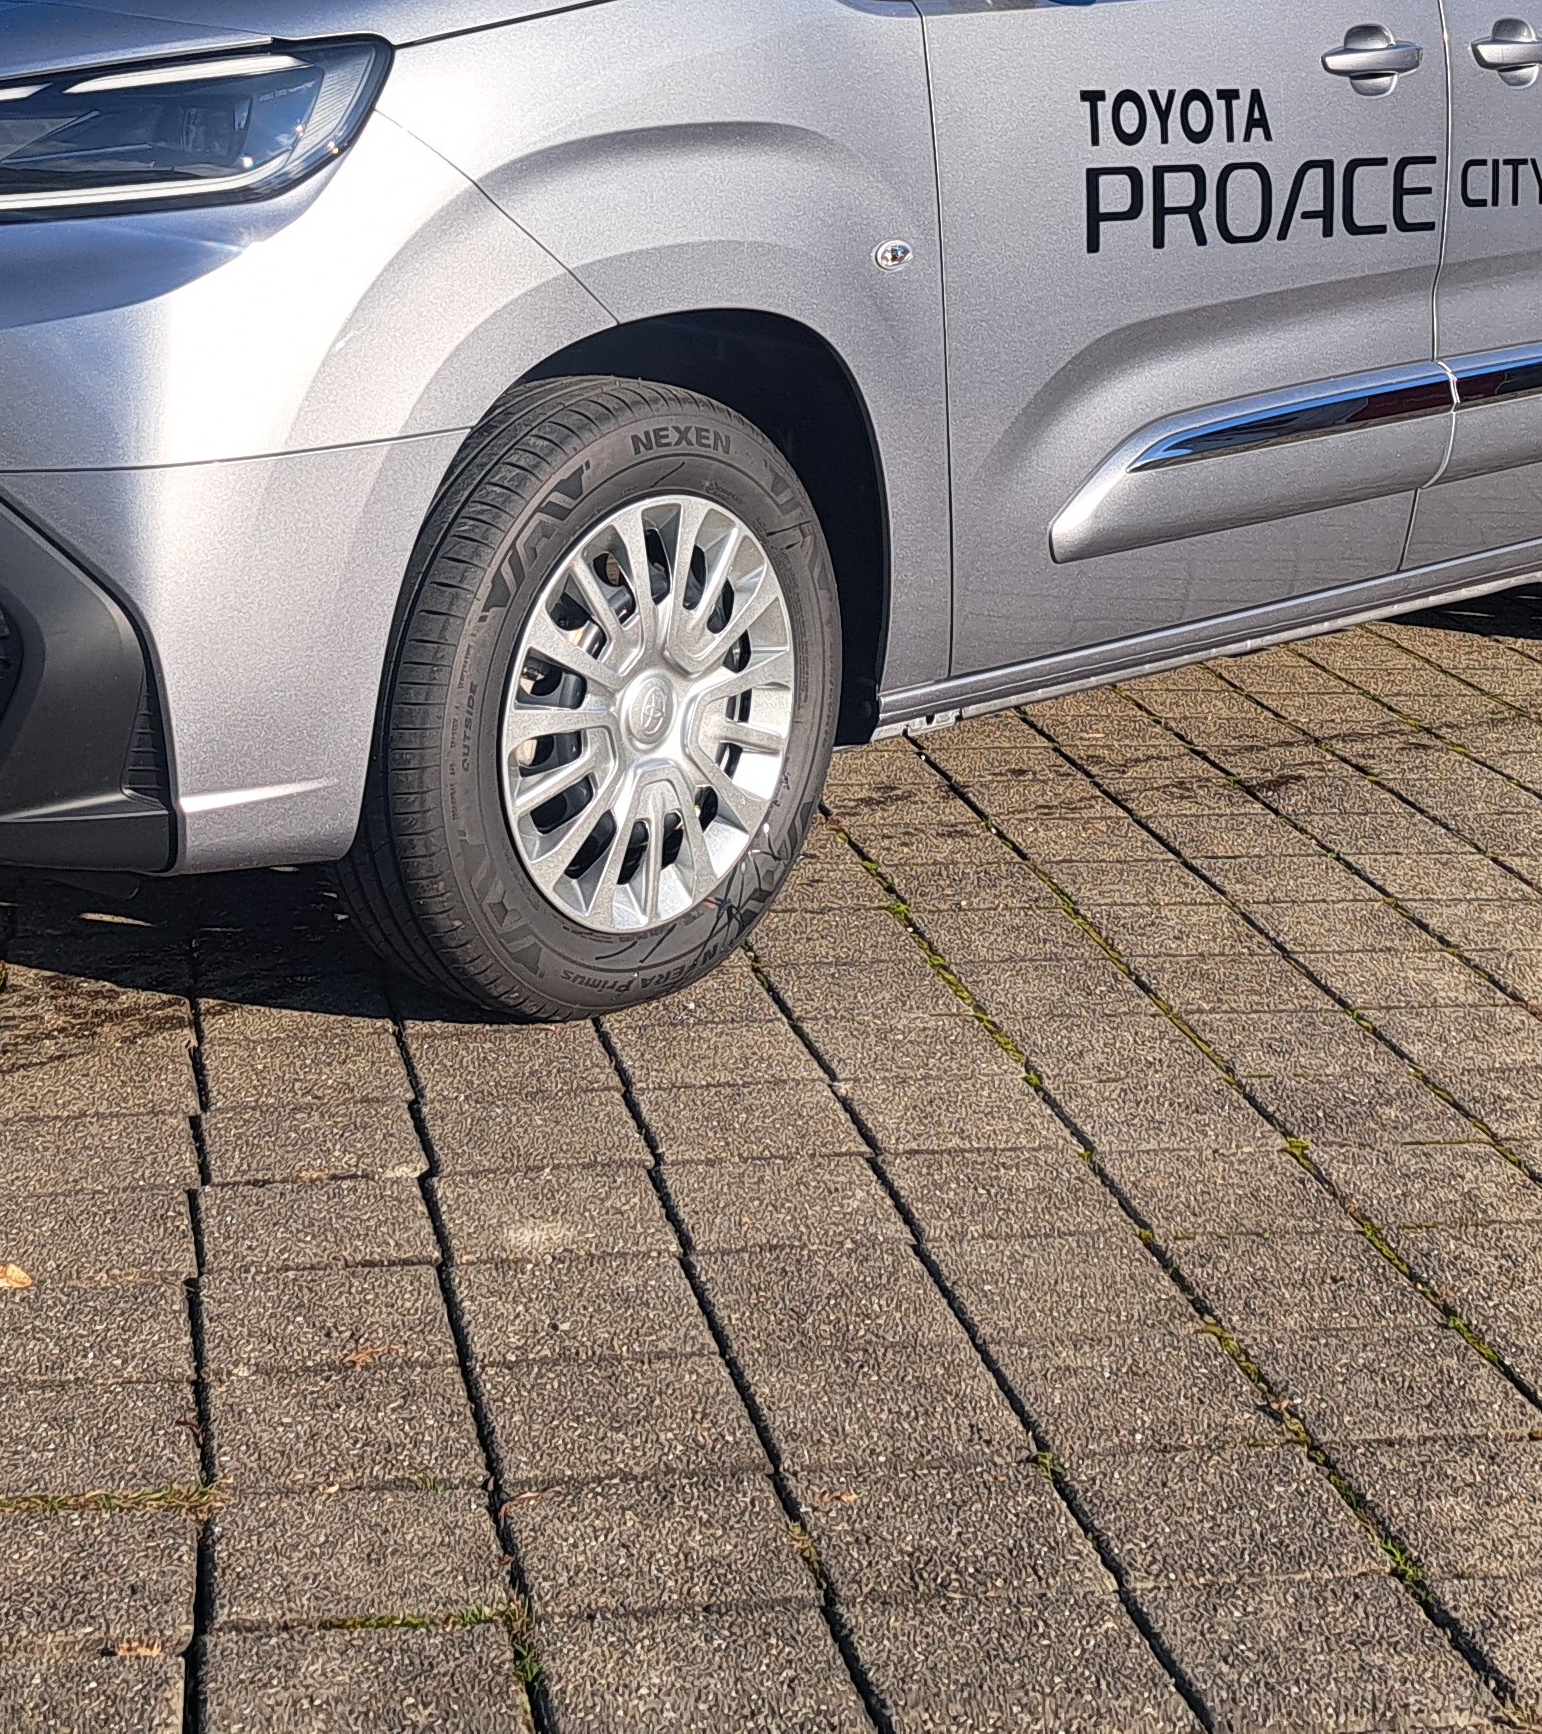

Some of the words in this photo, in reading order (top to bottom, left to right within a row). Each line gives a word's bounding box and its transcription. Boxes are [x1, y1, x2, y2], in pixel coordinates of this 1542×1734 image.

[1080, 88, 1273, 147] TOYOTA
[1084, 156, 1437, 254] PROACE
[630, 425, 732, 456] NEXEN
[461, 680, 479, 773] OUTSIDE
[560, 968, 632, 994] Primus
